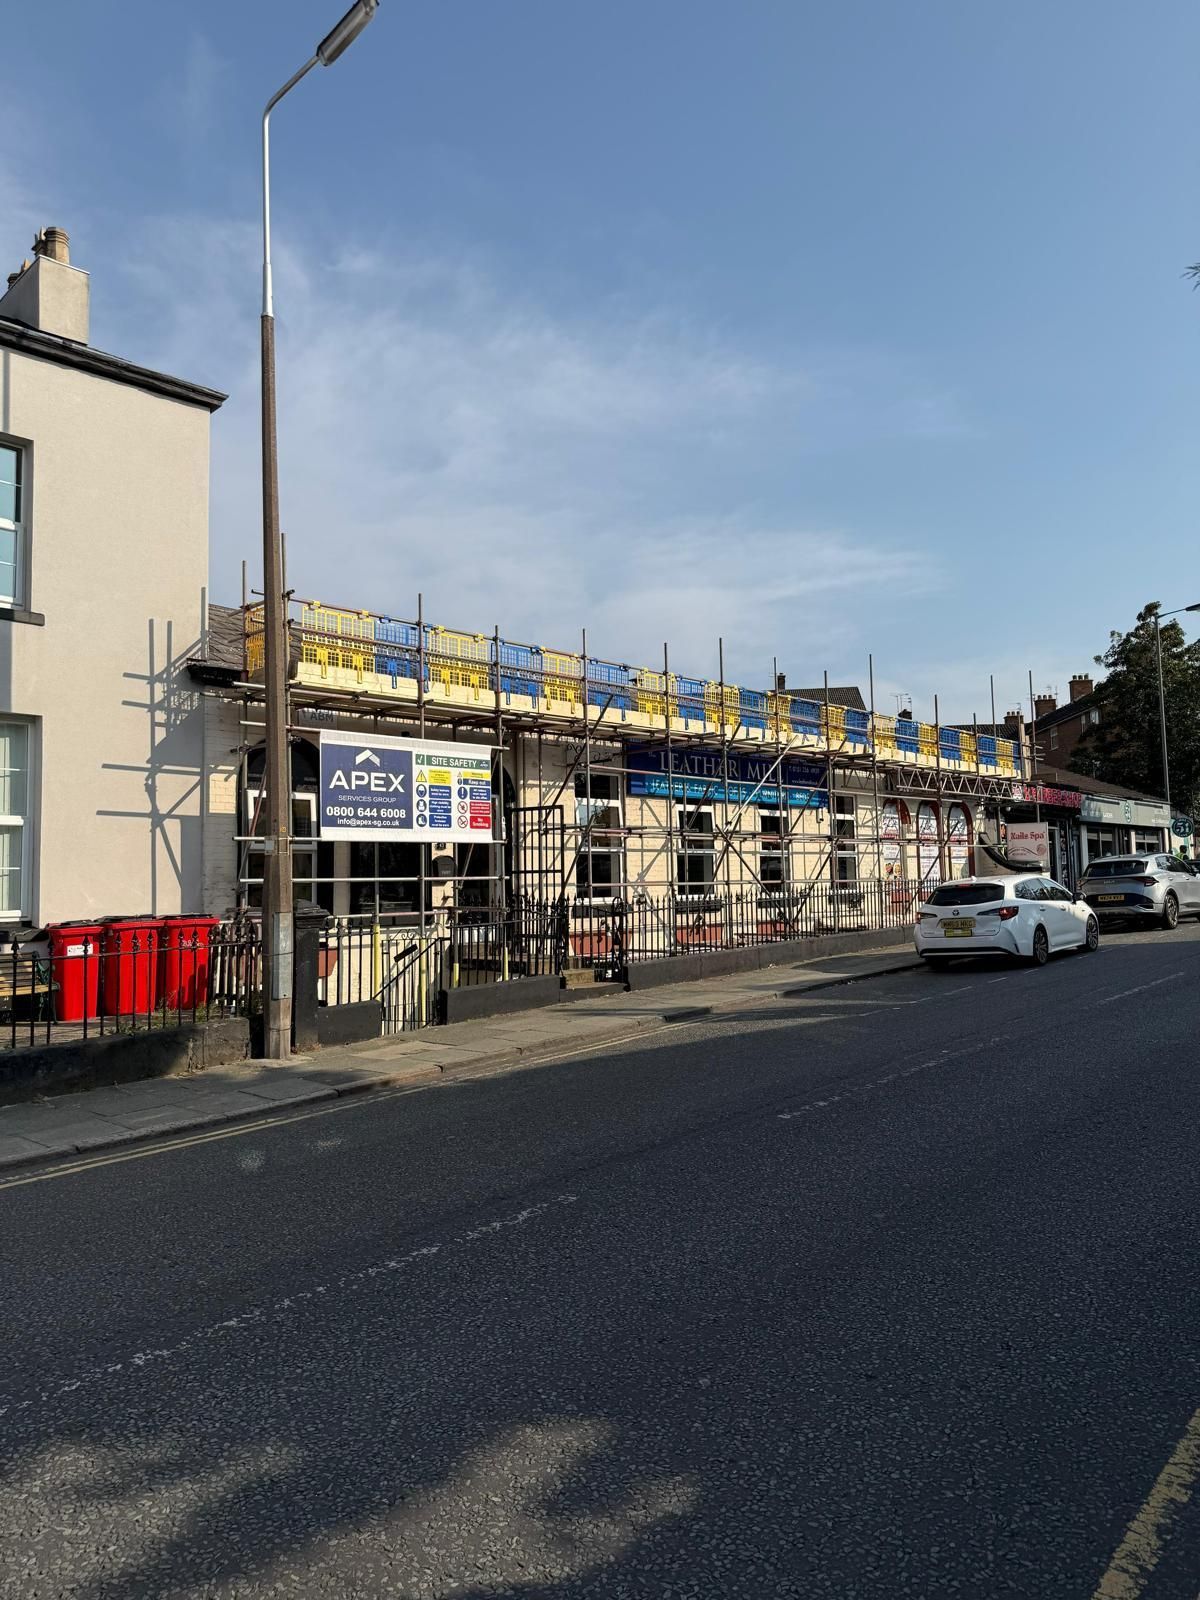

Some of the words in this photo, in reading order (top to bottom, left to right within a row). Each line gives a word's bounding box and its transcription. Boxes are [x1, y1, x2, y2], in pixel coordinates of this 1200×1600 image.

[431, 756, 448, 766] SITE
[449, 758, 477, 768] SAFETY
[329, 769, 405, 793] APEX
[652, 779, 683, 793] LEATER
[326, 806, 354, 816] 0800
[357, 807, 378, 817] 644
[380, 808, 406, 818] 6008
[337, 817, 400, 827] info@apex-sg.co.uk
[1029, 831, 1045, 841] Spa
